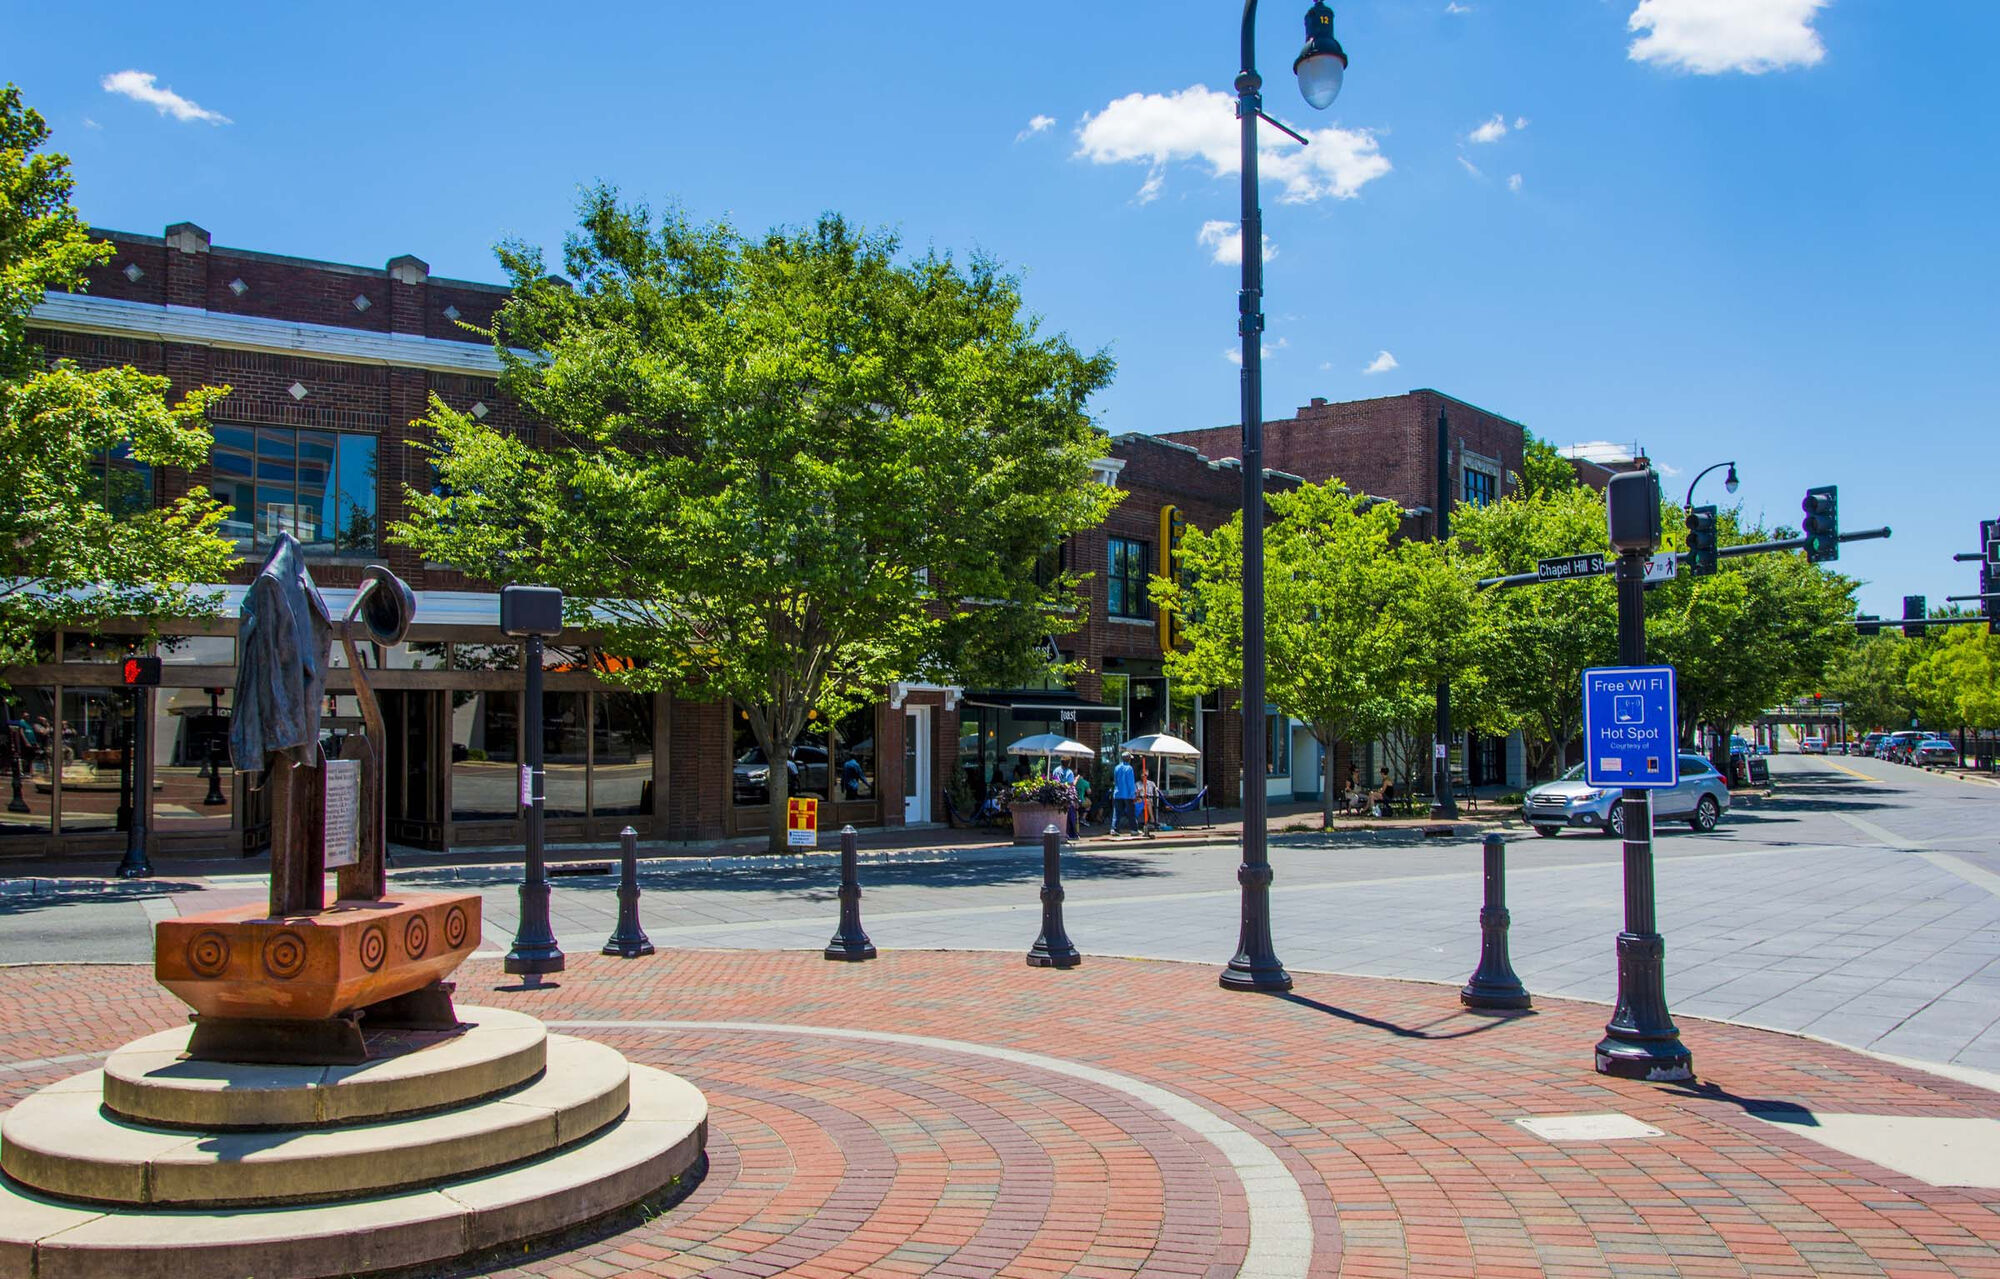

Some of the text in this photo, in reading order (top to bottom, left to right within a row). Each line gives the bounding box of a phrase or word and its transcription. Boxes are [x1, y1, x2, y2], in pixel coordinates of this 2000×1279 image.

[1320, 15, 1329, 24] 12
[1539, 557, 1604, 578] Chapel Hill St
[1595, 678, 1663, 692] Free WI FI
[1601, 727, 1659, 741] Hot Spot
[1610, 741, 1650, 750] Courtesy of
